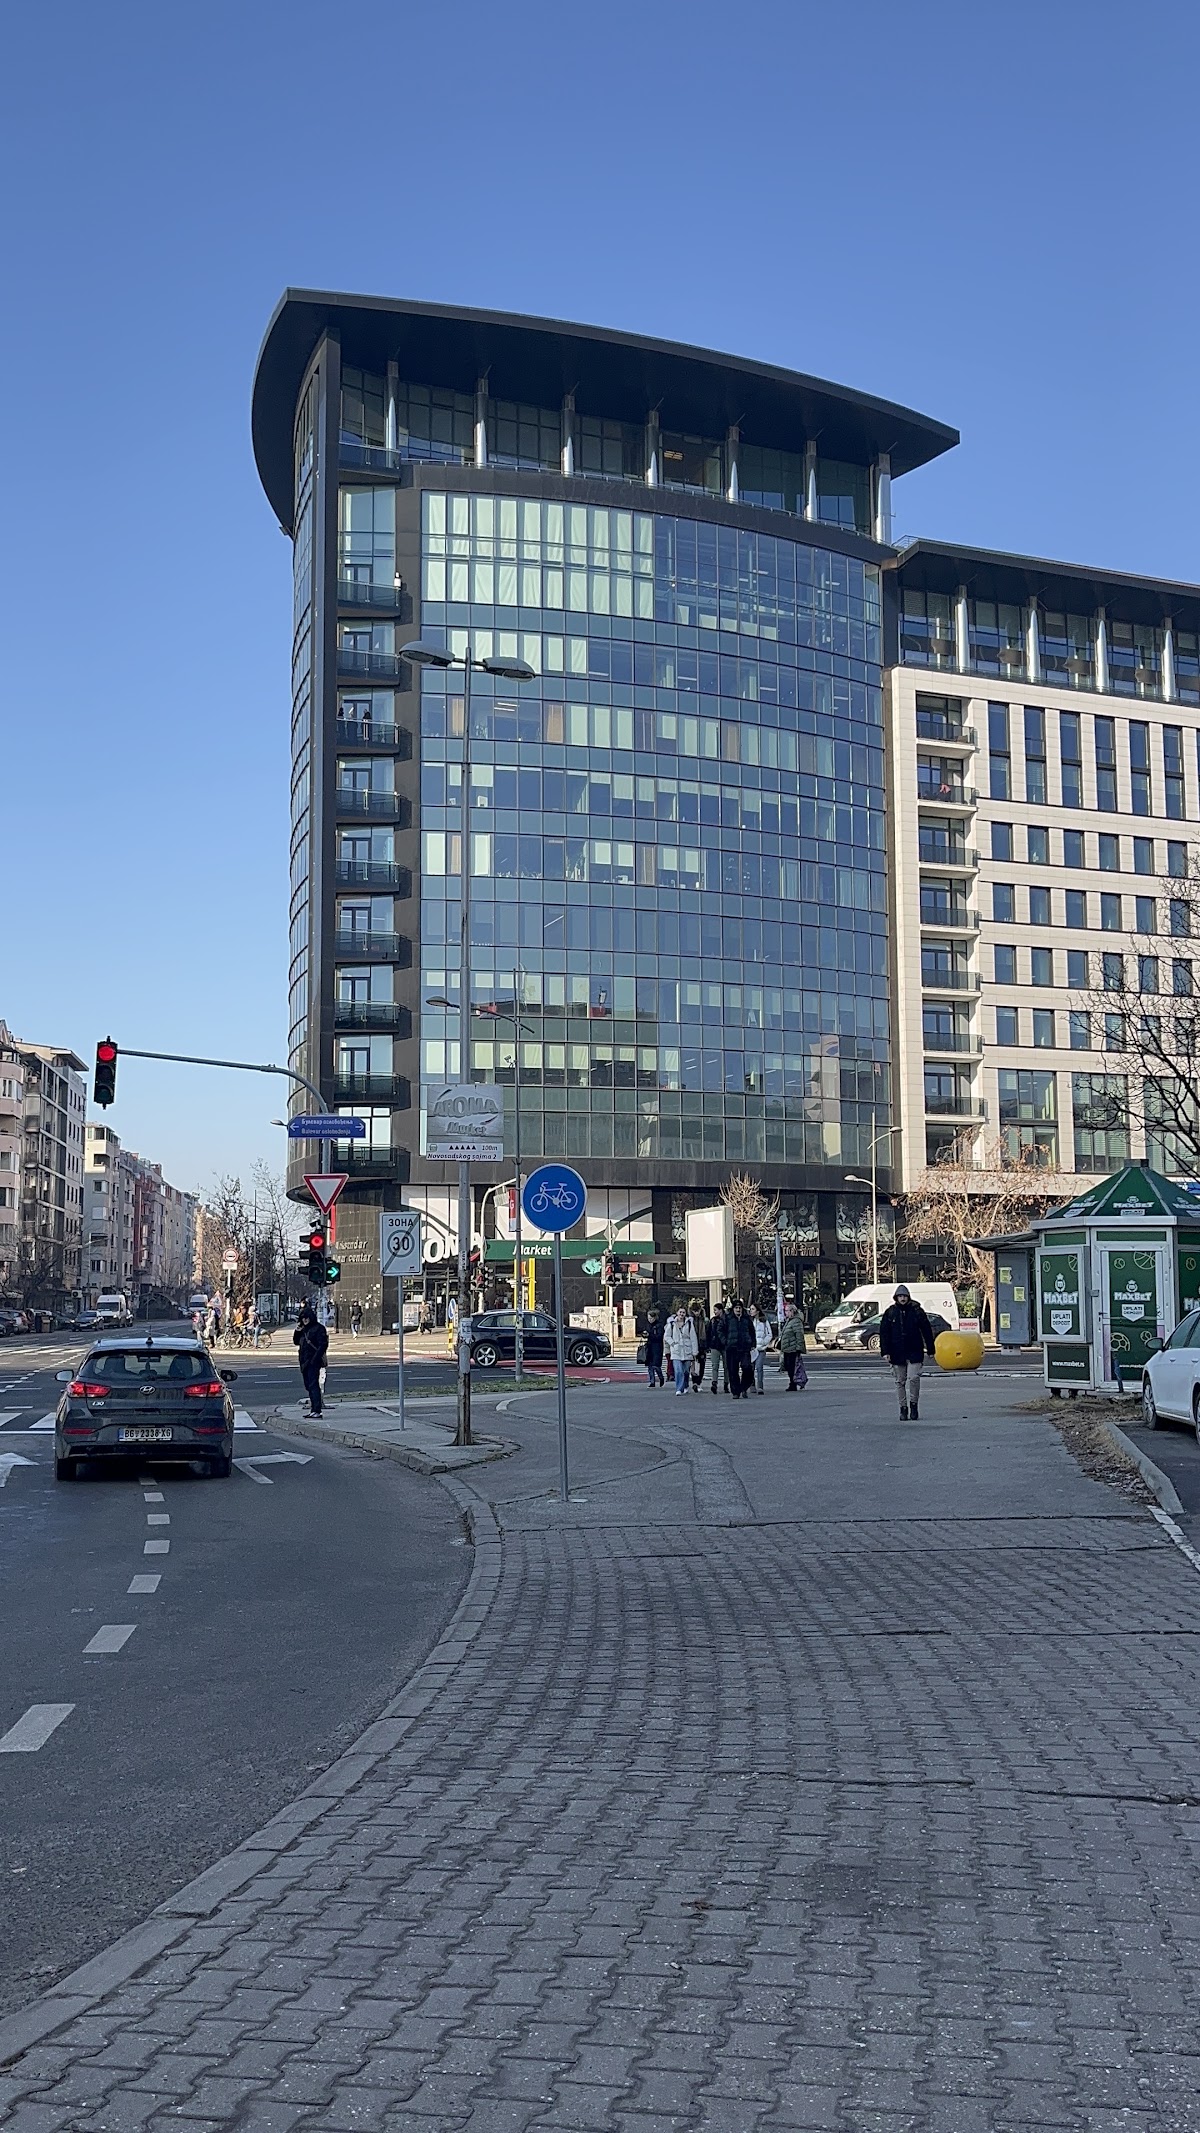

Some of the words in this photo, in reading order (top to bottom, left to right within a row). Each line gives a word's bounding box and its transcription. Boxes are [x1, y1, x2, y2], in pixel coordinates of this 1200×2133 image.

[433, 1096, 499, 1118] AROMA
[446, 1121, 487, 1136] Market
[1112, 1201, 1155, 1209] MAXBET
[388, 1218, 414, 1227] ЗОНА
[392, 1236, 410, 1251] 30
[1043, 1291, 1079, 1305] MAXBET
[1113, 1291, 1152, 1302] MAXBET
